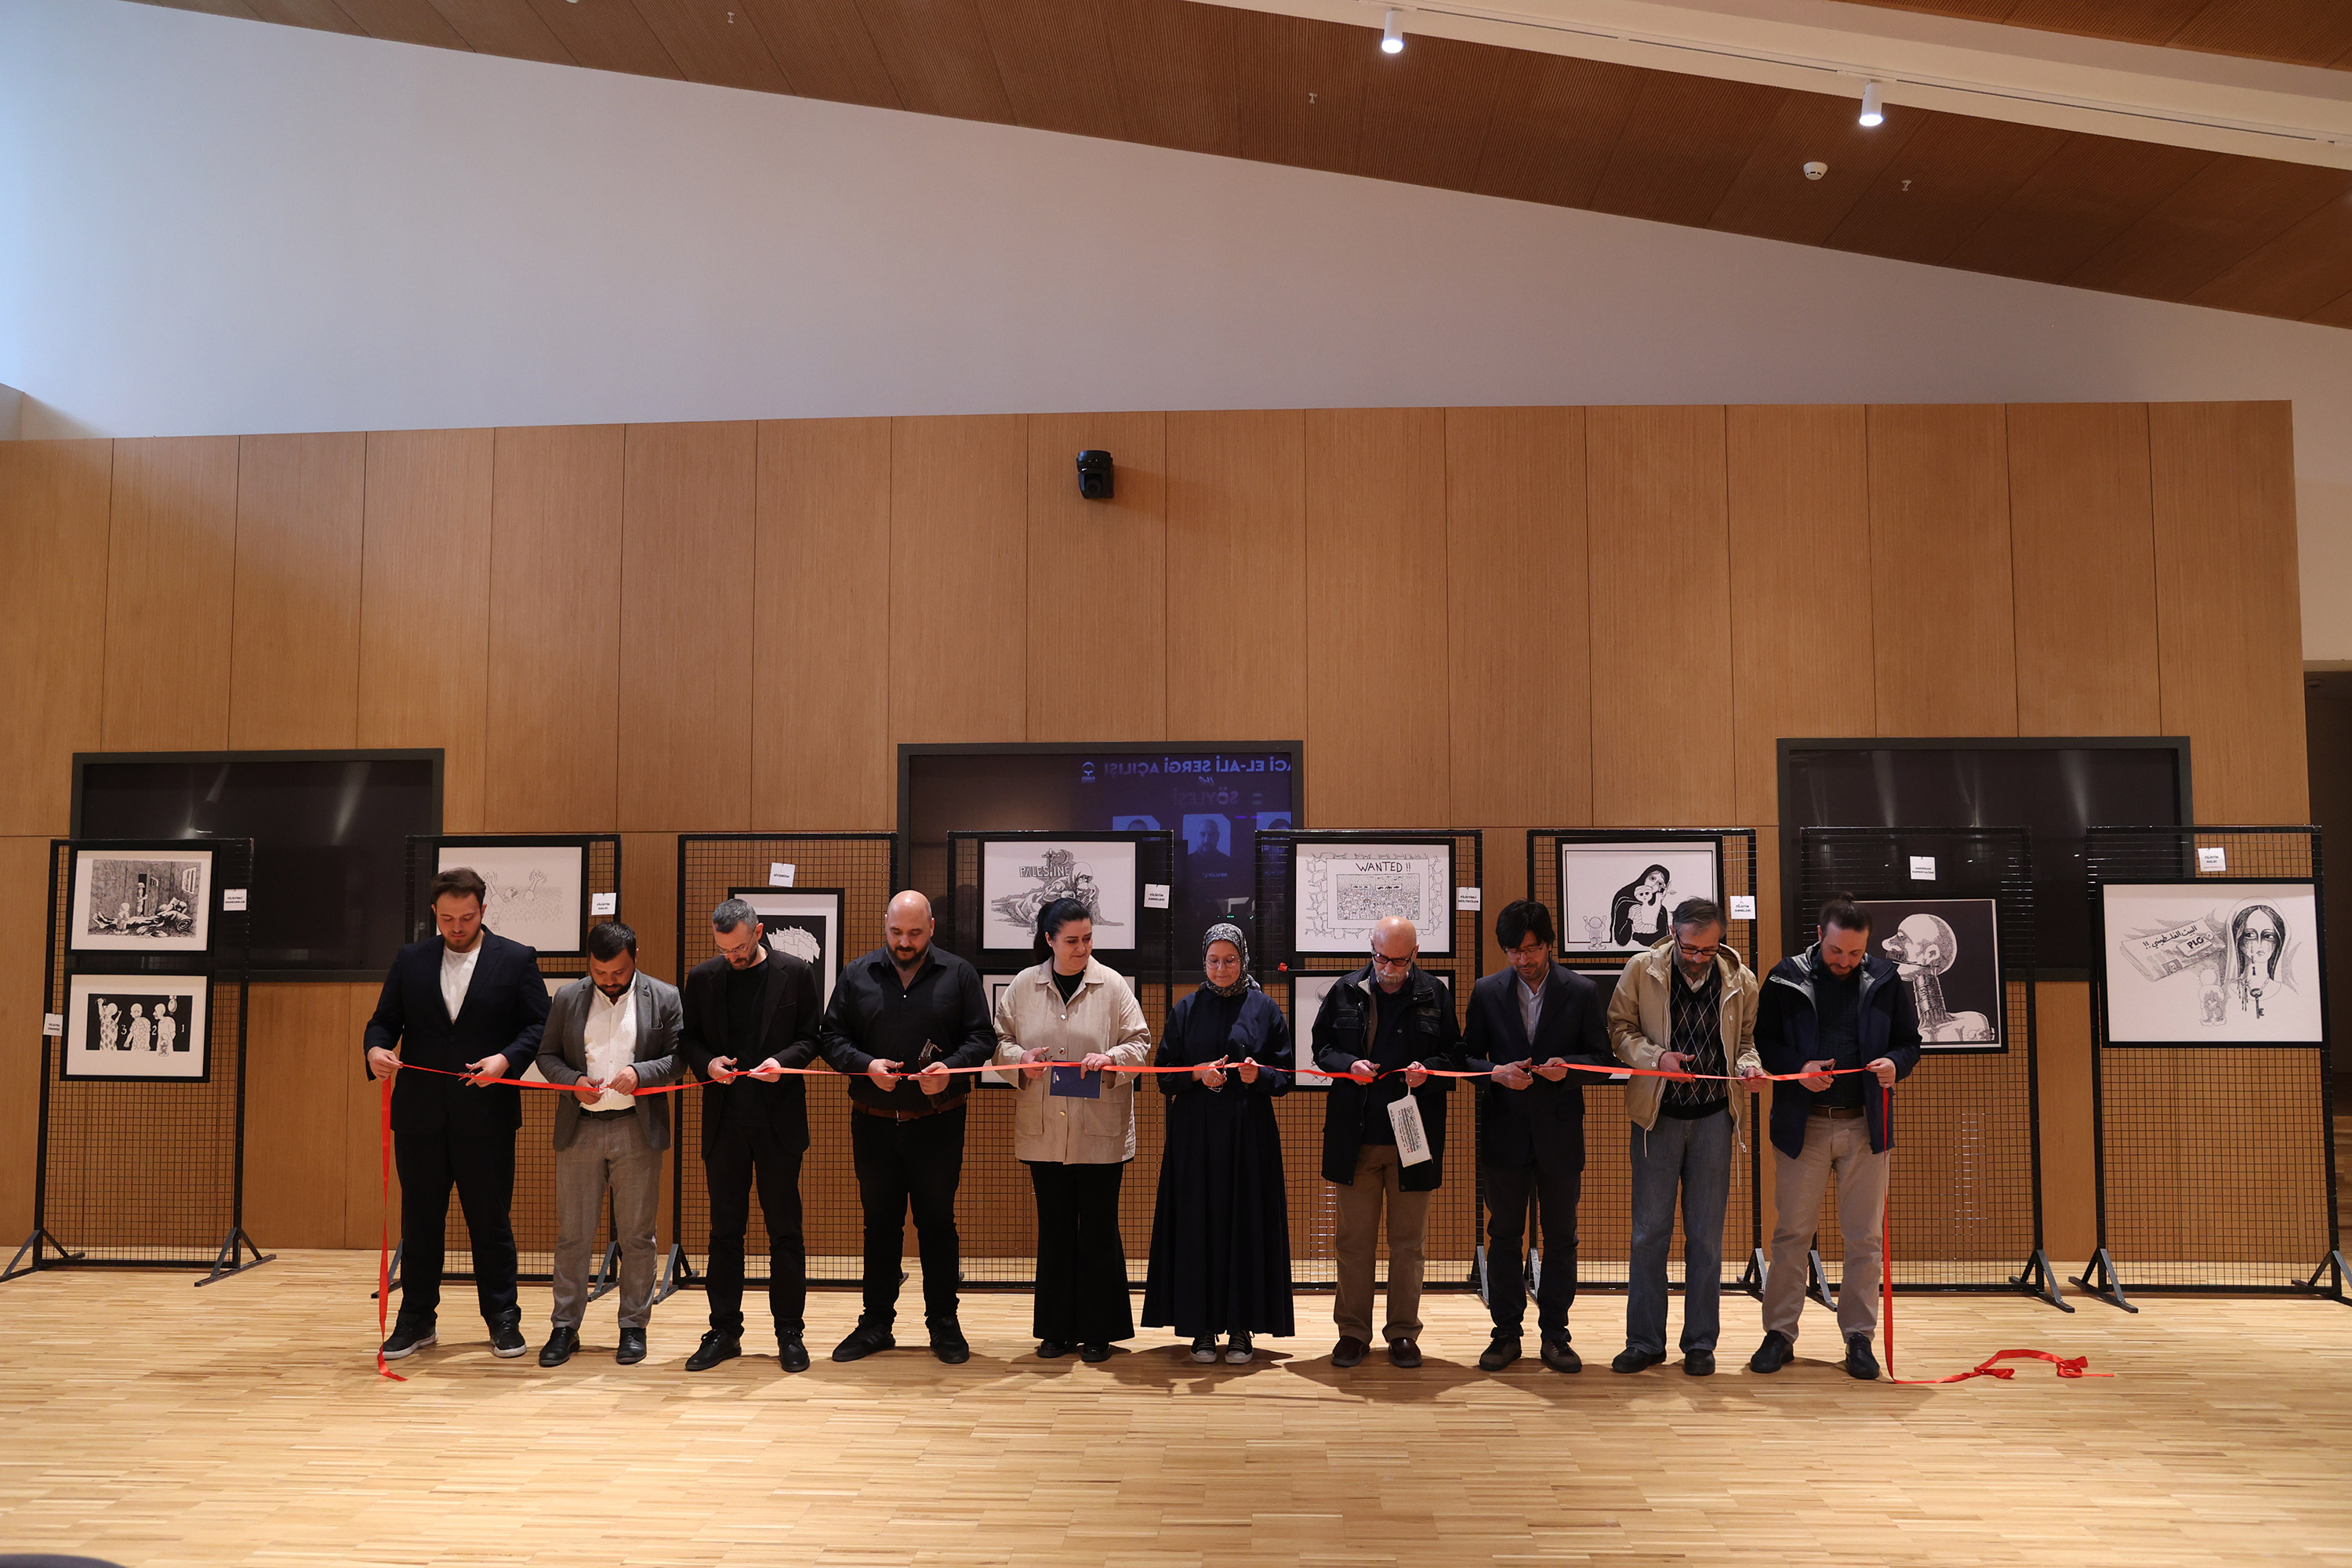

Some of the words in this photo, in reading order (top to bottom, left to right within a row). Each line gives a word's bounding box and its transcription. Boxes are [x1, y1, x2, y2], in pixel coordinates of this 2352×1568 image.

[1356, 862, 1403, 873] WANTED
[2182, 925, 2198, 937] البيت
[121, 1025, 127, 1035] 3
[151, 1025, 158, 1035] 2
[181, 1024, 186, 1033] 1
